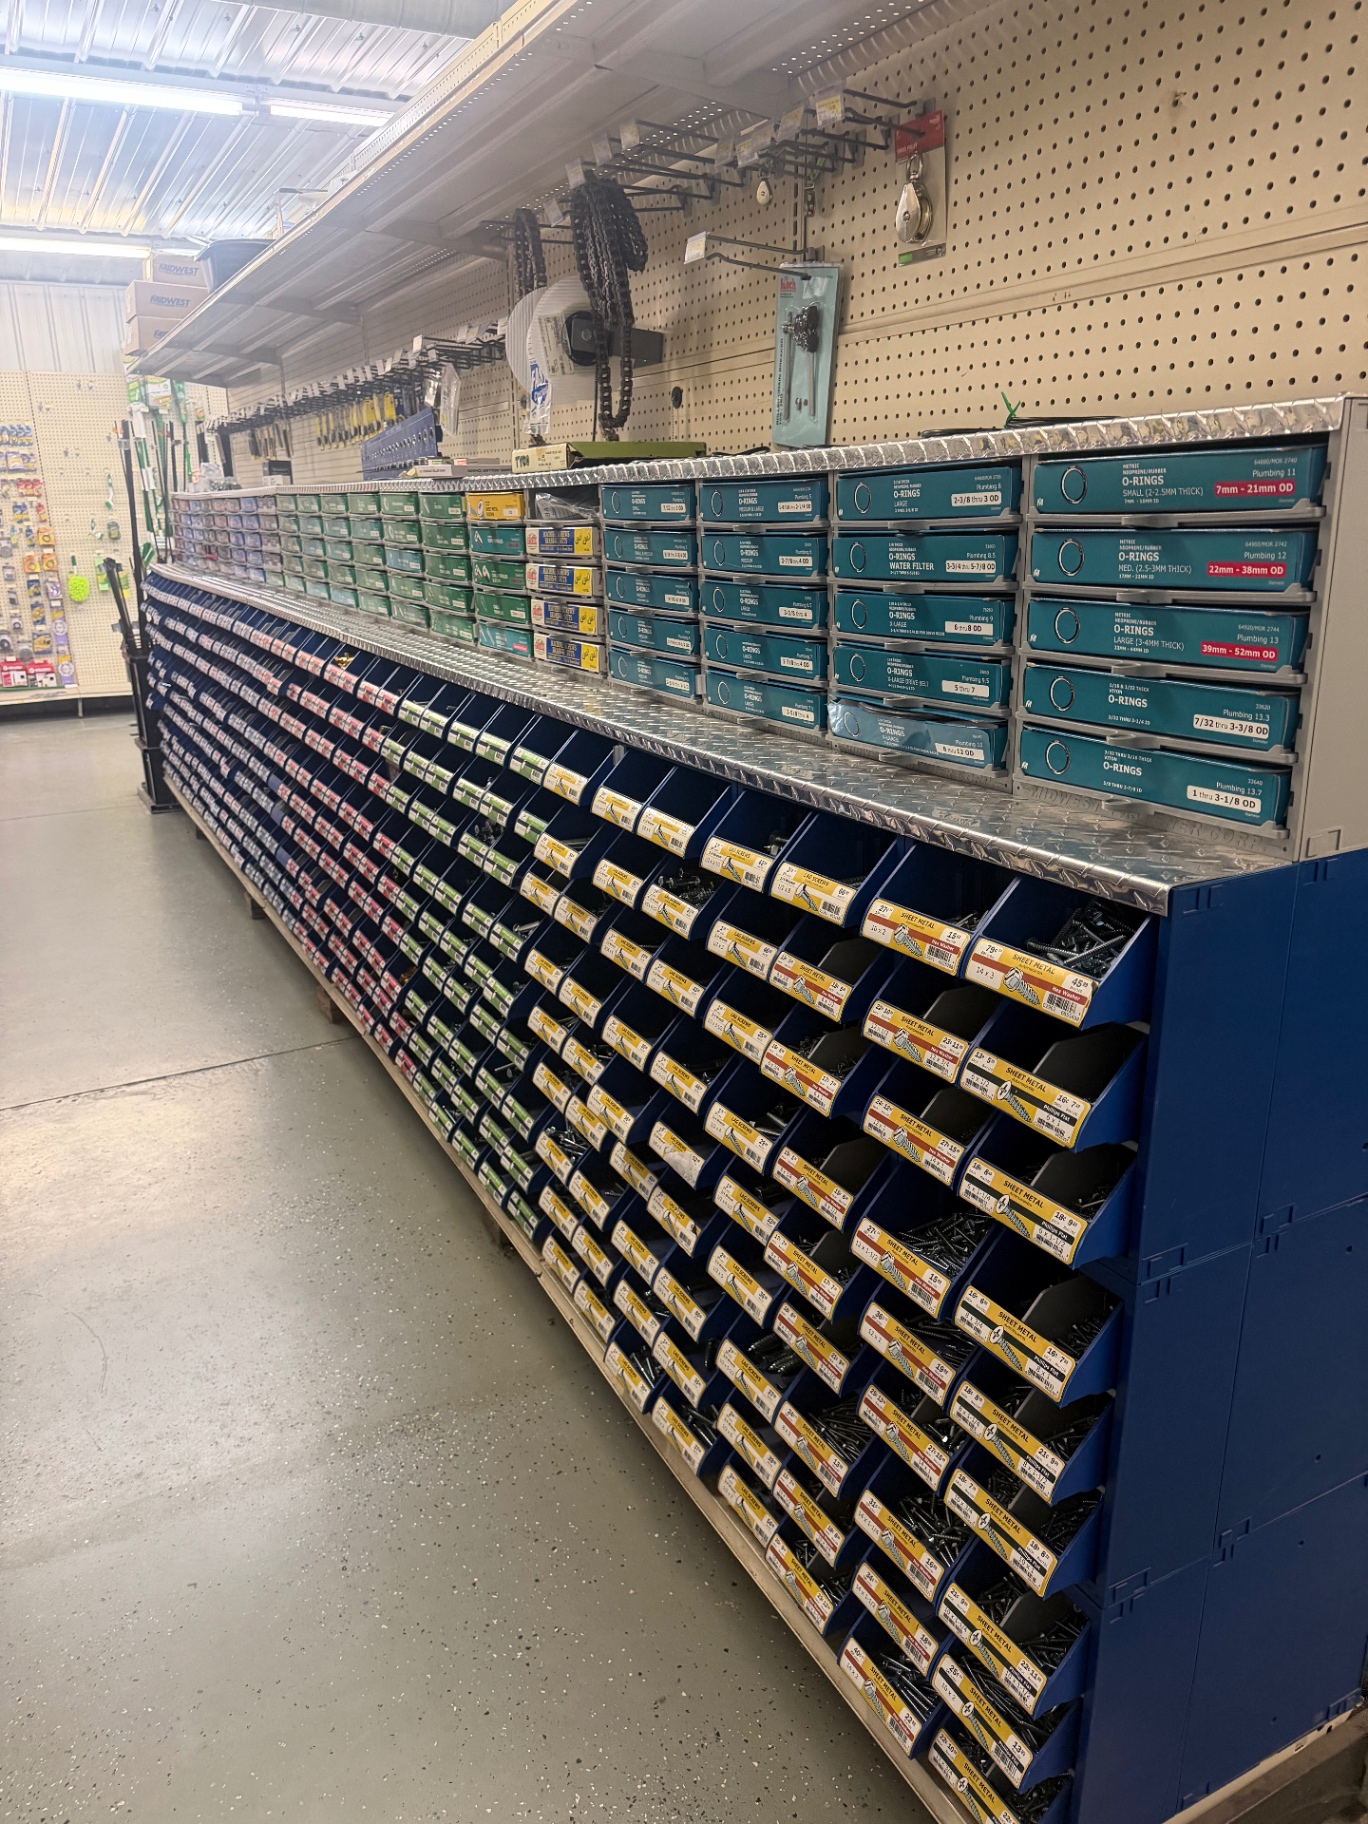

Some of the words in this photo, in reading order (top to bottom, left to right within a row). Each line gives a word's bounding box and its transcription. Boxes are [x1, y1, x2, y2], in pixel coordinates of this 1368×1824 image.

[159, 264, 199, 276] MIDWEST
[150, 294, 191, 308] MIDWEST
[1122, 476, 1164, 486] O-RINGS
[1253, 470, 1284, 478] Plumbing
[894, 490, 920, 498] O-RINGS
[1123, 489, 1144, 497] SMALL
[1145, 488, 1176, 497] (2-2.5MM
[1179, 486, 1203, 496] THICK)
[1216, 486, 1238, 494] 7mm
[1247, 484, 1276, 493] 21mm
[1279, 483, 1293, 492] OD
[1119, 552, 1159, 561] O-RINGS
[1244, 552, 1275, 560] Plumbing
[913, 562, 934, 570] FILTER
[1119, 564, 1133, 572] MED.
[1136, 564, 1166, 573] (2.5-3MM
[1168, 565, 1192, 574] THICK)
[1209, 565, 1233, 574] 22mm
[1242, 566, 1268, 574] 38mm
[1270, 566, 1284, 574] OD
[889, 612, 915, 620] O-RINGS
[1114, 625, 1154, 636] O-RINGS
[1237, 634, 1267, 644] Plumbing
[1114, 637, 1133, 645] LARGE
[1135, 638, 1159, 647] (3-4MM
[1161, 640, 1185, 650] THICK)
[1202, 645, 1227, 655] 39mm
[1234, 649, 1260, 658] 52mm
[1262, 651, 1275, 659] OD
[887, 668, 912, 676] O-RINGS
[1108, 695, 1147, 707] O-RINGS
[1223, 709, 1253, 720] Plumbing
[1255, 712, 1269, 721] 13.3
[1195, 717, 1213, 727] 7/32
[1216, 721, 1227, 729] thru
[1229, 723, 1253, 733] 3-3/8
[1256, 727, 1268, 735] OD
[1103, 762, 1142, 776] O-RINGS
[1216, 782, 1245, 794] Plumbing
[1248, 787, 1262, 796] 13.7
[1200, 791, 1213, 800] thru
[1215, 794, 1240, 805] 3-1/8
[1243, 799, 1255, 808] OD
[803, 872, 812, 880] LAG
[812, 874, 829, 886] SCREWS
[900, 912, 917, 922] SHEET
[917, 918, 935, 929] METAL
[939, 942, 954, 951] Washer
[1012, 953, 1032, 965] SHEET
[1031, 960, 1055, 975] METAL
[989, 971, 995, 979] 3
[1051, 985, 1062, 993] Hex
[1061, 990, 1080, 1001] Washer
[900, 1016, 917, 1027] SHEET
[917, 1023, 934, 1036] METAL
[938, 1050, 953, 1060] Washer
[1005, 1066, 1025, 1081] SHEET
[1025, 1077, 1047, 1092] METAL
[1042, 1104, 1060, 1117] Phillips
[1059, 1113, 1070, 1122] Flat
[899, 1113, 915, 1126] SHEET
[915, 1123, 932, 1137] METAL
[803, 1164, 816, 1175] SHEET
[816, 1173, 828, 1187] METAL
[739, 1192, 747, 1201] LAG
[747, 1197, 760, 1212] SCREWS
[1002, 1179, 1023, 1195] SHEET
[1022, 1191, 1044, 1208] METAL
[1040, 1220, 1058, 1234] Phillips
[1057, 1230, 1068, 1240] Flat
[886, 1239, 902, 1253] SHEET
[901, 1250, 918, 1265] METAL
[733, 1264, 741, 1273] LAG
[740, 1271, 753, 1285] SCREWS
[997, 1310, 1017, 1328] SHEET
[1017, 1324, 1037, 1342] METAL
[894, 1325, 909, 1341] SHEET
[909, 1338, 925, 1354] METAL
[891, 1408, 906, 1425] SHEET
[905, 1422, 921, 1439] METAL
[992, 1408, 1010, 1426] SHEET
[1010, 1423, 1029, 1442] METAL
[742, 1423, 750, 1433] LAG
[749, 1431, 762, 1448] SCREWS
[802, 1423, 815, 1438] SHEET
[814, 1434, 826, 1450] METAL
[1032, 1468, 1047, 1485] 1-1/2
[741, 1486, 749, 1496] LAG
[748, 1494, 761, 1511] SCREWS
[985, 1497, 1002, 1516] SHEET
[1002, 1513, 1021, 1533] METAL
[887, 1514, 901, 1532] SHEET
[900, 1528, 916, 1548] METAL
[883, 1589, 897, 1607] SHEET
[896, 1603, 911, 1623] METAL
[976, 1614, 994, 1635] SHEET
[993, 1631, 1012, 1653] METAL
[869, 1665, 883, 1683] SHEET
[882, 1681, 896, 1701] METAL
[969, 1686, 986, 1707] SHEET
[984, 1705, 1002, 1727] METAL
[963, 1762, 978, 1783] SHEET
[978, 1780, 995, 1803] METAL
